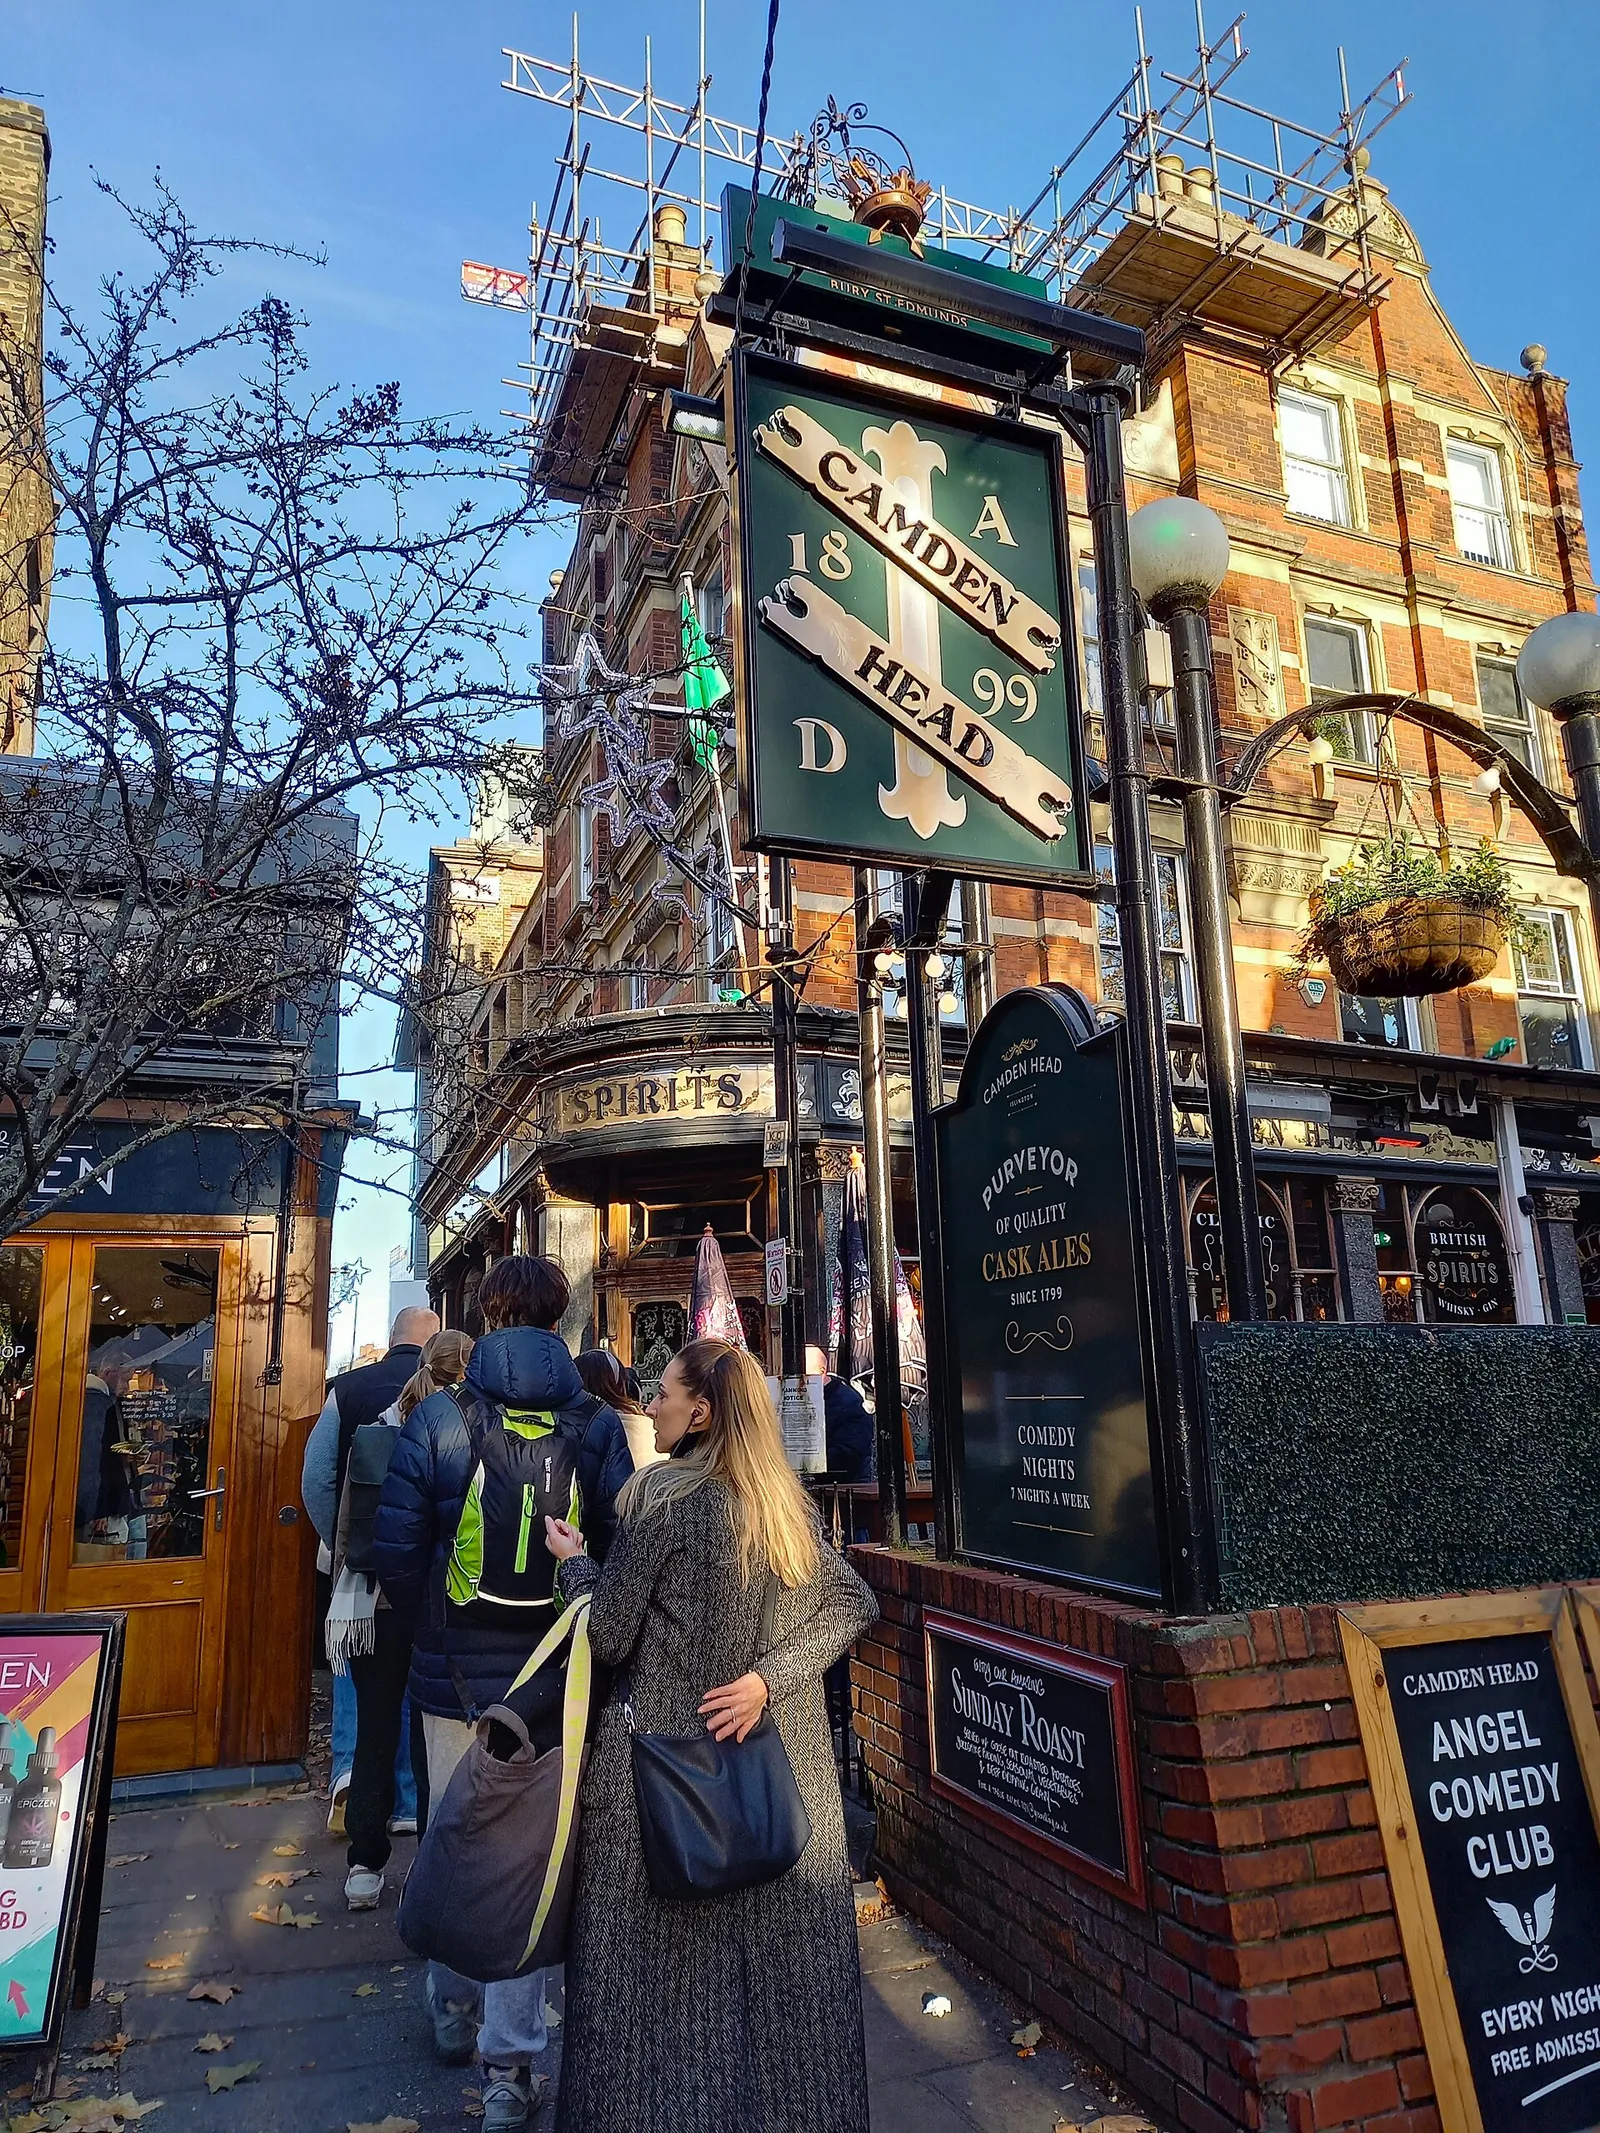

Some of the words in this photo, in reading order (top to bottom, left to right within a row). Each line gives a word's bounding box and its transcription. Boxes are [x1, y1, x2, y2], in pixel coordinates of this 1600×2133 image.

[818, 451, 1020, 627] CAMDEN
[970, 495, 1019, 548] A
[787, 530, 853, 580] 18
[854, 644, 995, 768] HEAD
[972, 668, 1038, 724] 99
[792, 717, 848, 774] D
[573, 1073, 743, 1124] SPIRITS
[983, 1060, 1027, 1105] CAMDEN
[1030, 1056, 1062, 1074] HEAD
[982, 1146, 1078, 1211] PURVEYOR
[996, 1216, 1010, 1235] OF
[1014, 1202, 1066, 1233] QUALITY
[1429, 1232, 1486, 1247] BRITISH
[982, 1245, 1033, 1281] CASK
[1038, 1232, 1091, 1272] ALES
[1427, 1261, 1498, 1284] SPIRITS
[1011, 1289, 1037, 1306] SINCE
[1040, 1286, 1062, 1301] 1799
[1438, 1297, 1475, 1316] WHISKY
[1482, 1298, 1499, 1312] GIN
[1018, 1425, 1075, 1447] COMEDY
[1022, 1456, 1075, 1480] NIGHTS
[1010, 1486, 1015, 1499] 7
[1017, 1487, 1050, 1504] NIGHTS
[1053, 1492, 1059, 1505] A
[1062, 1492, 1091, 1509] WEEK
[1403, 1666, 1485, 1696] CAMDEN
[1487, 1660, 1539, 1686] HEAD
[951, 1667, 1014, 1737] SUNDAY
[1019, 1693, 1086, 1769] ROAST
[1433, 1709, 1541, 1762] ANGEL
[17, 1799, 57, 1809] EPICZEN
[1429, 1762, 1560, 1822] COMEDY
[1466, 1825, 1555, 1879] CLUB
[1481, 1997, 1543, 2038] EVERY
[1551, 1984, 1600, 2021] NIGH
[1490, 2046, 1532, 2076] FREE
